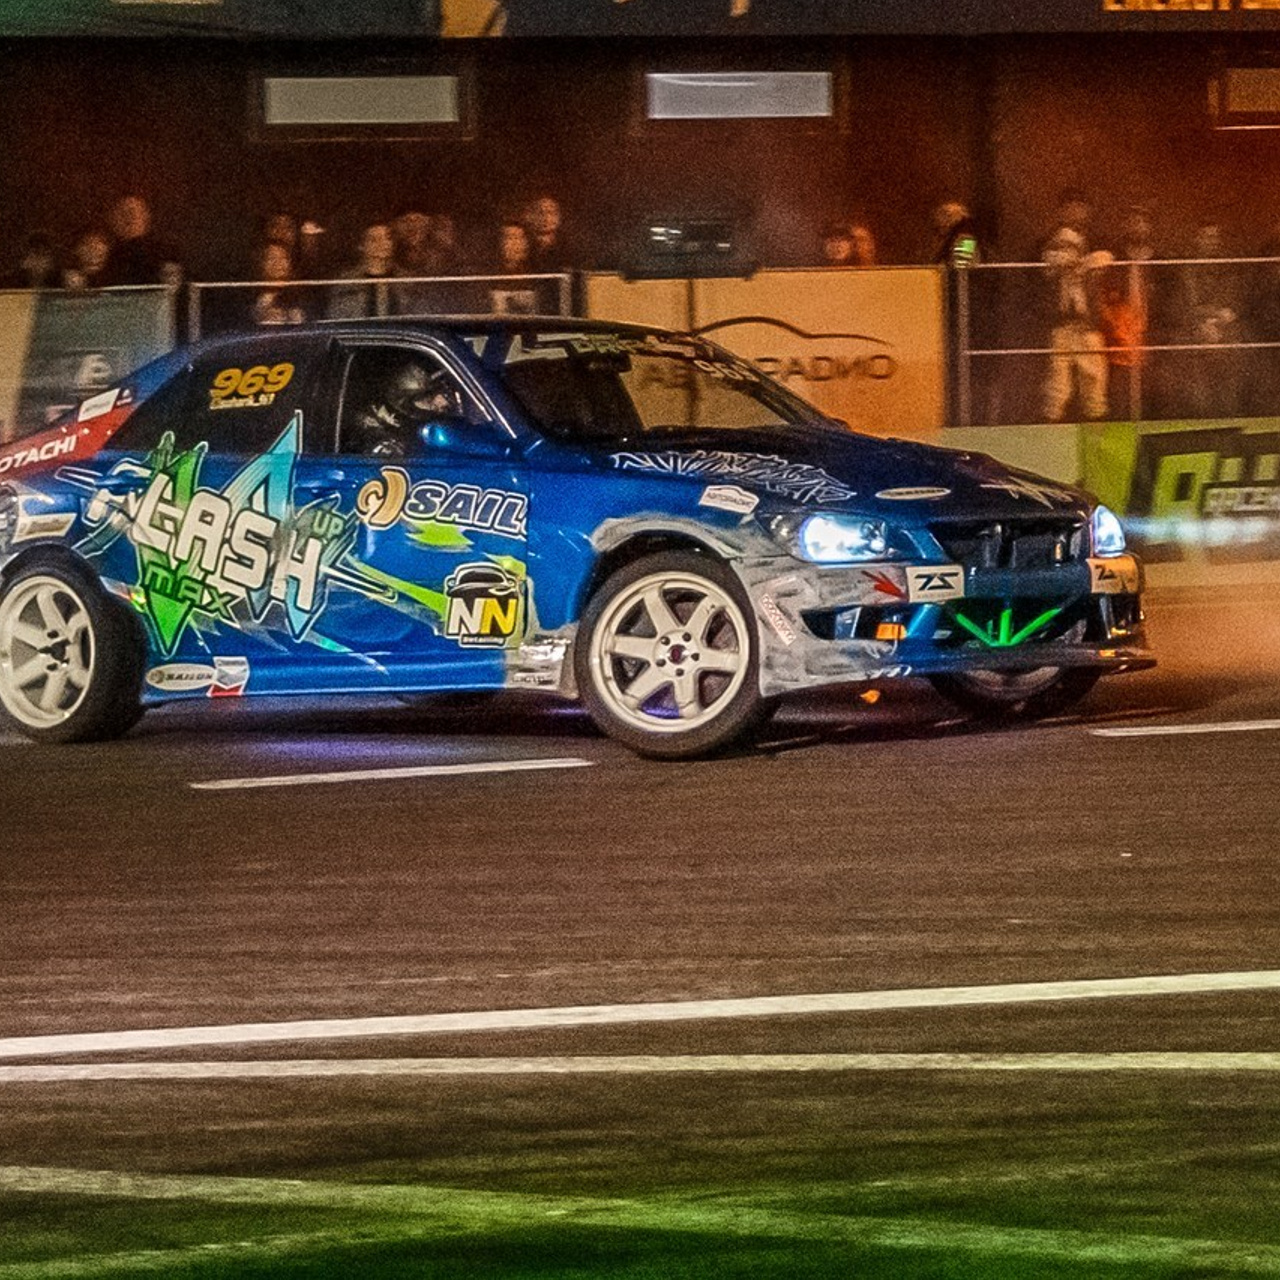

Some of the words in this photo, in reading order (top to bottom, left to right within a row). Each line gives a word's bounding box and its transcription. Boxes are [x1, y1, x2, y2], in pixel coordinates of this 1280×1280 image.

[214, 362, 295, 396] 969
[313, 512, 344, 537] UP
[402, 480, 528, 538] SAIL
[446, 596, 518, 635] NN
